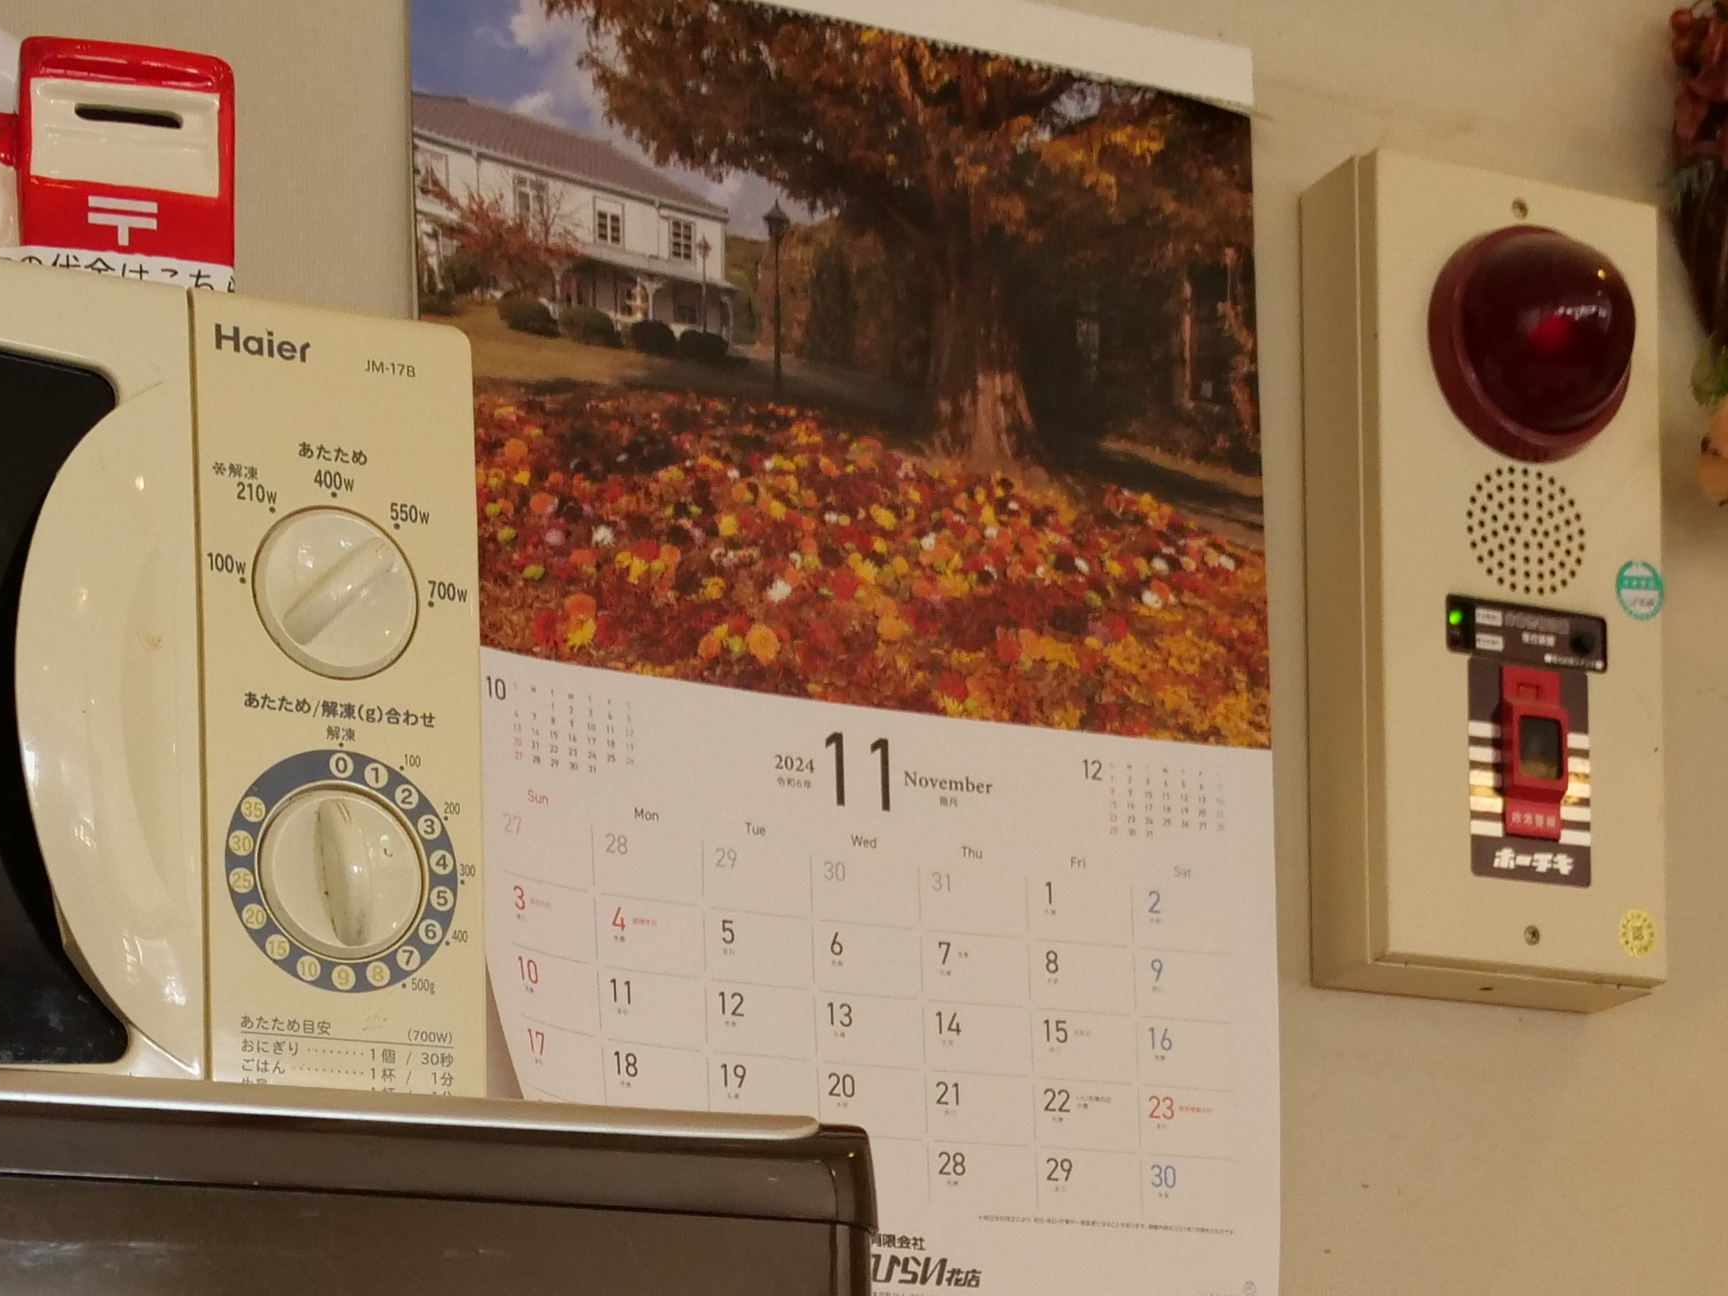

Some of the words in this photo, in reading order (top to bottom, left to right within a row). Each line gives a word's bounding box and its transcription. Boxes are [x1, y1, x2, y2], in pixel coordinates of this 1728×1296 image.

[214, 323, 311, 363] Haier
[364, 359, 416, 378] JM-17B
[298, 441, 368, 465] あたため
[486, 676, 506, 701] 10
[326, 725, 356, 742] 解凍
[335, 758, 347, 773] 0
[403, 754, 421, 768] 100
[773, 754, 815, 773] 2024
[371, 767, 380, 783] 1
[824, 731, 891, 812] 11
[903, 770, 994, 795] November
[1081, 759, 1102, 781] 12
[400, 789, 414, 805] 2
[243, 802, 264, 818] 35
[443, 802, 461, 816] 200
[423, 819, 436, 835] 3
[527, 789, 549, 805] Sun
[633, 806, 660, 822] Mon
[744, 822, 766, 836] Tue
[850, 834, 877, 849] Wed
[961, 846, 983, 860] Thu
[1070, 856, 1086, 869] Fri
[1174, 866, 1192, 879] Sat
[231, 837, 252, 852] 30
[435, 854, 449, 871] 4
[502, 813, 522, 835] 27
[605, 833, 628, 855] 28
[714, 848, 738, 868] 29
[823, 862, 846, 882] 30
[931, 872, 952, 892] 31
[1045, 881, 1053, 905] 1
[1148, 890, 1162, 914] 2
[1493, 847, 1575, 876] ホーチキ
[459, 864, 476, 878] 300
[232, 873, 252, 888] 25
[436, 891, 449, 907] 5
[245, 909, 265, 925] 20
[424, 924, 437, 940] 6
[451, 930, 468, 944] 400
[513, 885, 526, 910] 3
[611, 907, 626, 931] 4
[721, 920, 735, 945] 5
[830, 932, 844, 956] 6
[938, 941, 951, 966] 7
[1045, 950, 1059, 974] 8
[1150, 958, 1164, 982] 9
[402, 950, 415, 966] 7
[299, 961, 319, 977] 10
[372, 966, 385, 982] 8
[337, 970, 350, 986] 9
[411, 978, 435, 995] 500g
[517, 955, 539, 985] 10
[609, 978, 632, 1005] 11
[718, 991, 745, 1017] 12
[827, 1002, 853, 1028] 13
[935, 1011, 962, 1036] 14
[1043, 1019, 1069, 1044] 15
[1148, 1027, 1173, 1051] 16
[241, 1014, 331, 1036] あたため目安
[407, 1030, 453, 1044] (700W)
[241, 1038, 299, 1056] おにぎり
[421, 1052, 454, 1067] 30秒
[241, 1057, 287, 1075] ごはん
[526, 1028, 545, 1056] 17
[613, 1051, 638, 1077] 18
[720, 1063, 747, 1089] 19
[828, 1073, 856, 1099] 20
[935, 1081, 961, 1106] 21
[1043, 1088, 1071, 1113] 22
[1148, 1096, 1175, 1121] 23
[938, 1151, 966, 1176] 28
[1046, 1157, 1073, 1183] 29
[1151, 1164, 1177, 1190] 30
